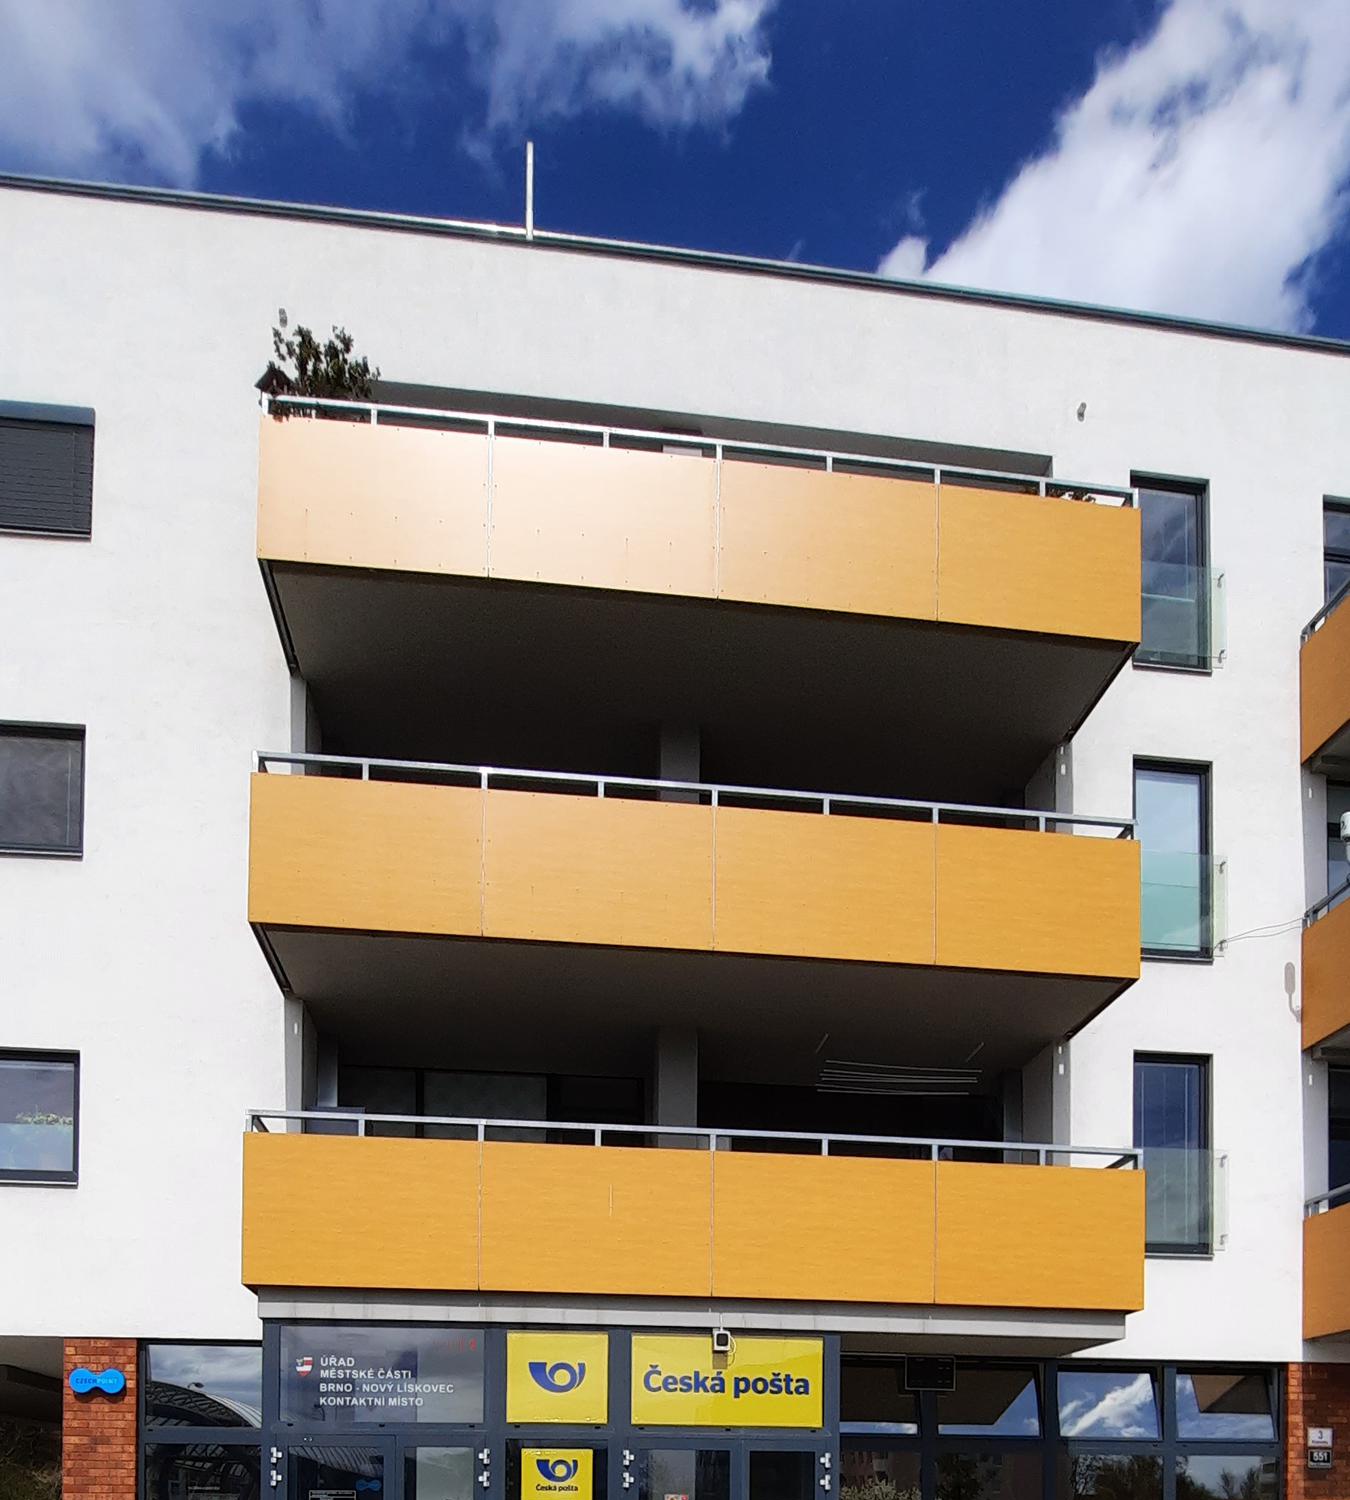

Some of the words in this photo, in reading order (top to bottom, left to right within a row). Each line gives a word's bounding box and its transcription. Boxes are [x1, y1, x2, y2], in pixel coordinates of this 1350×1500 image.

[320, 1354, 355, 1367] ÚŘAD
[320, 1368, 375, 1379] MĚSTSKÉ
[377, 1368, 412, 1379] ČÁSTI
[319, 1383, 353, 1393] BRNO
[362, 1381, 394, 1393] NOVÝ
[396, 1381, 454, 1393] LÍSKOVEC
[643, 1364, 725, 1393] Česká
[733, 1372, 810, 1399] pošta
[319, 1395, 385, 1406] KONTAKTNÍ
[388, 1395, 424, 1407] MÍSTO
[1317, 1430, 1323, 1440] 3
[536, 1483, 557, 1491] Česká
[558, 1484, 578, 1492] pošta
